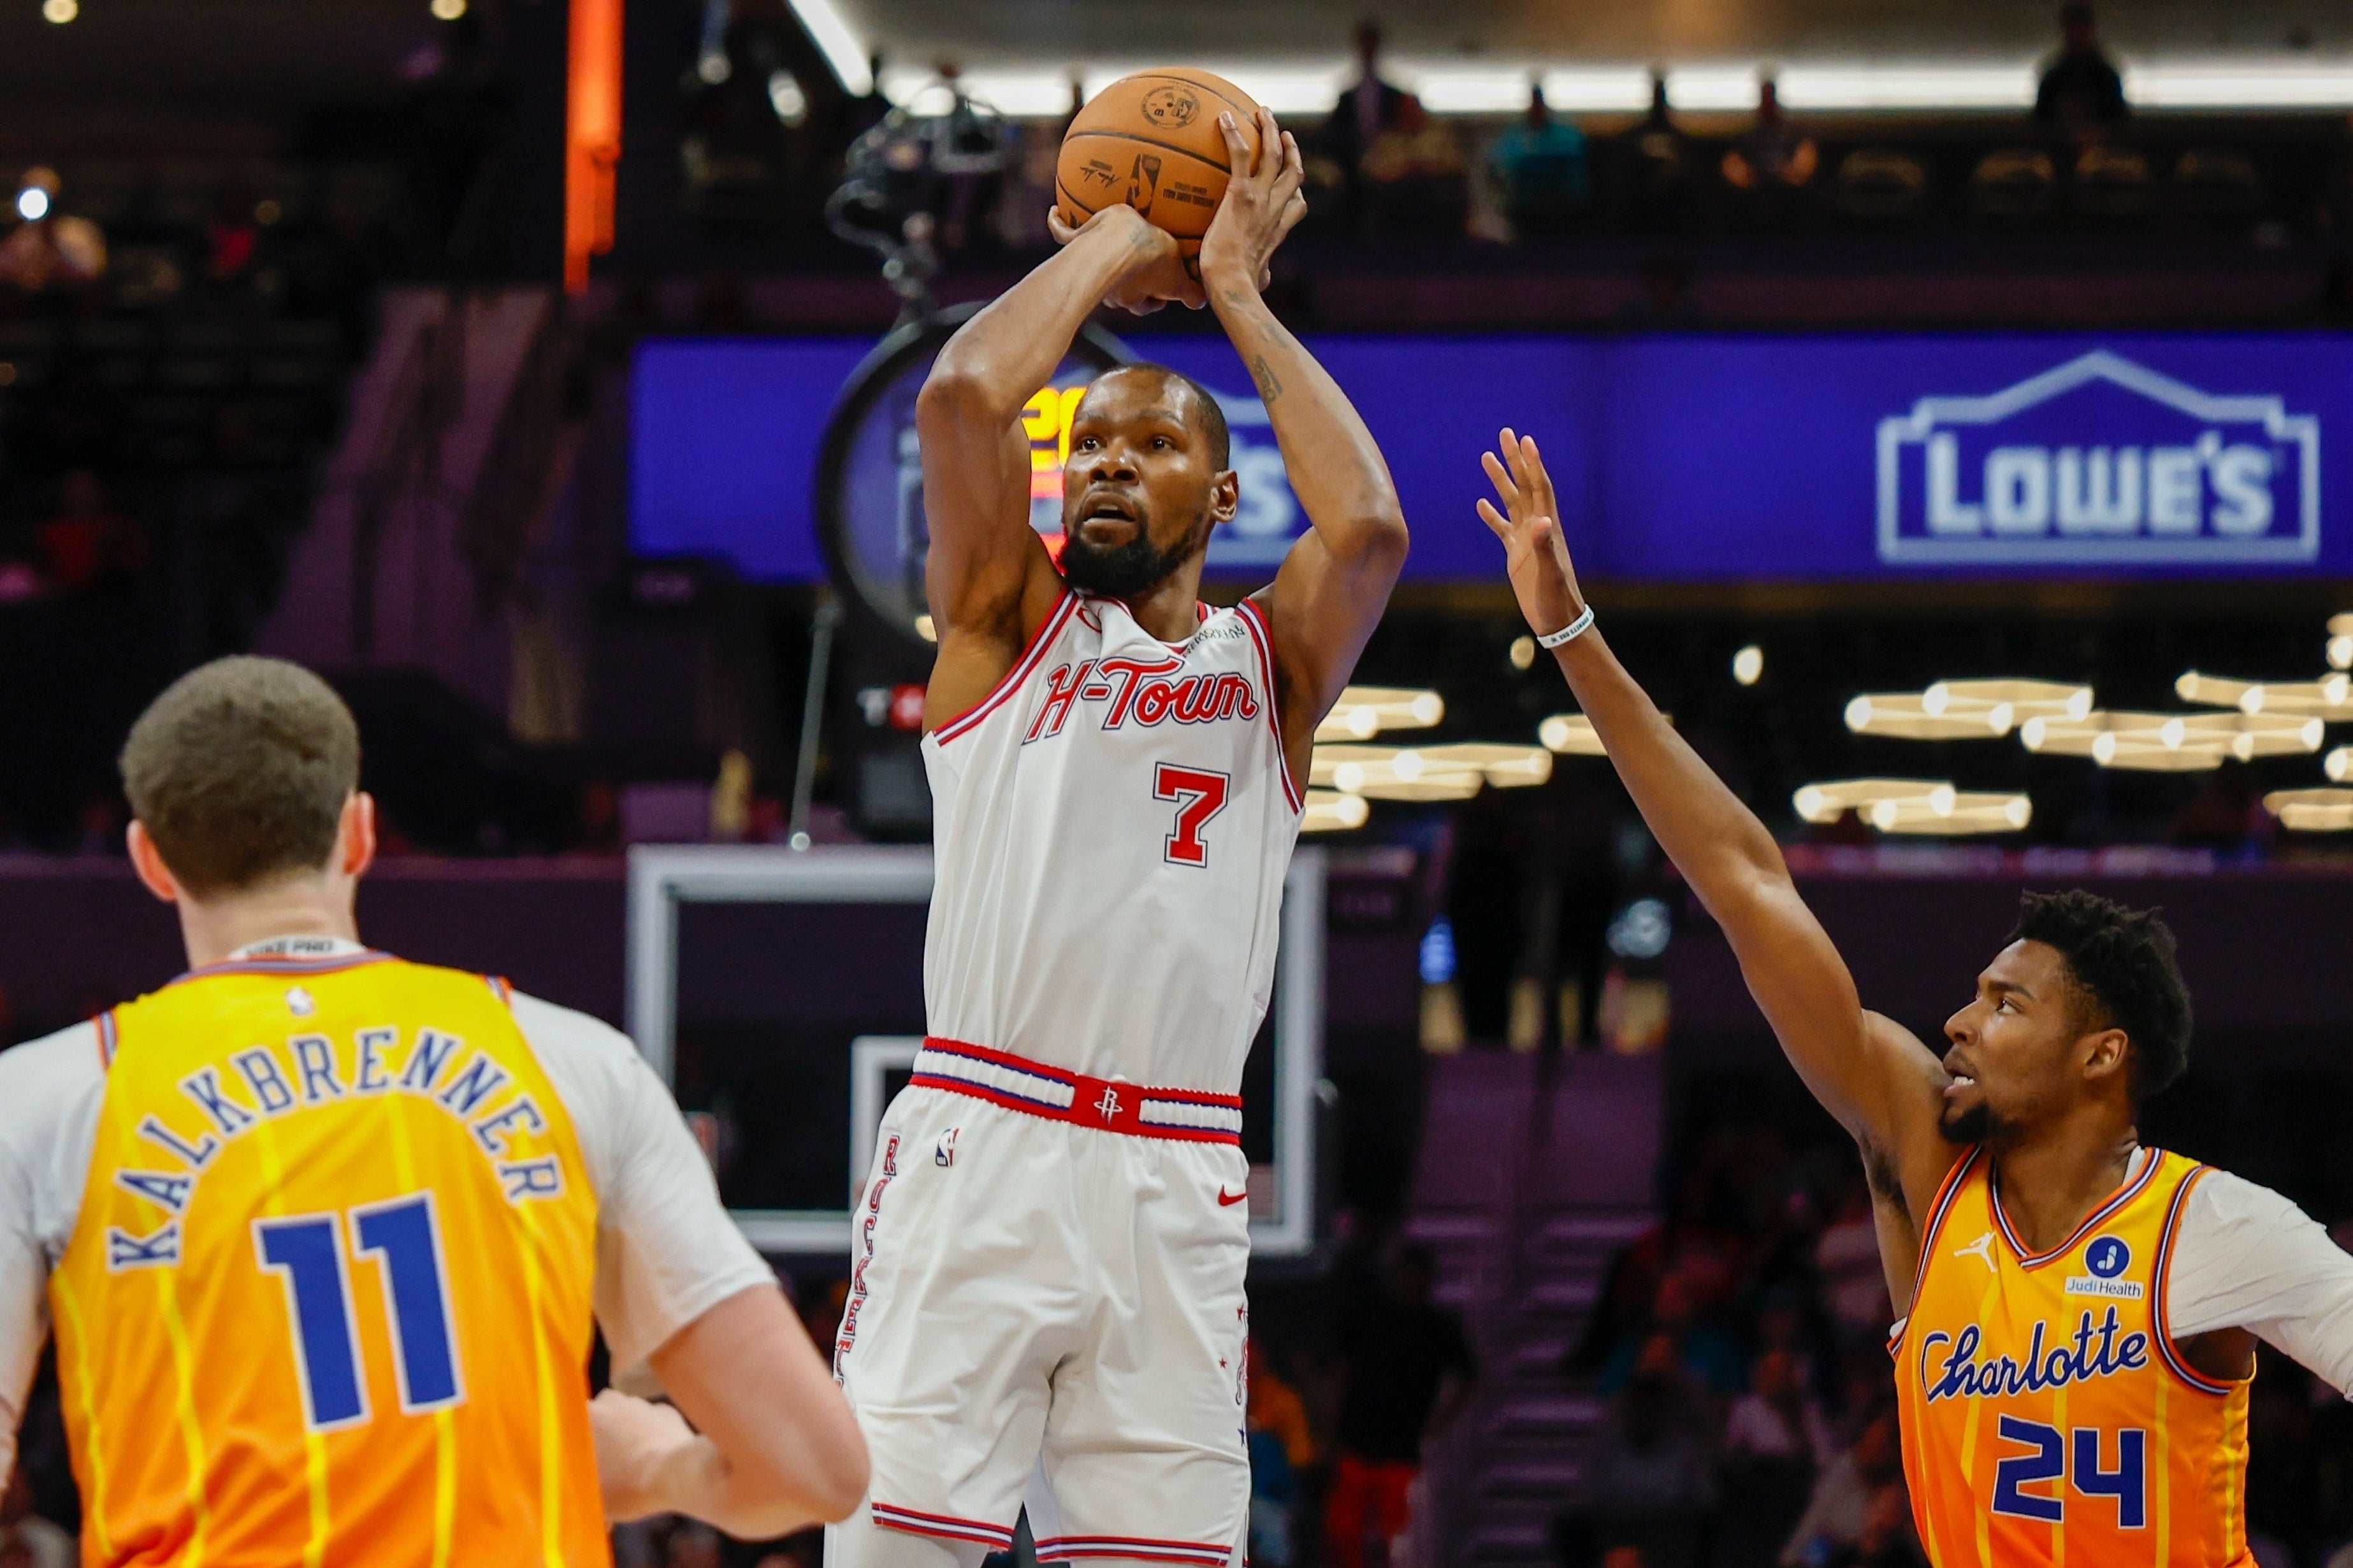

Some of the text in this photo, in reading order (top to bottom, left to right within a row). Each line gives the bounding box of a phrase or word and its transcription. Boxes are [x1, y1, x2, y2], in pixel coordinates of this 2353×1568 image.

[1925, 431, 2273, 536] LOWE'S
[1022, 656, 1259, 745] H-Town
[1152, 762, 1230, 868] 7
[107, 1025, 565, 1274] KALKBRENNER
[252, 1189, 467, 1435] 11
[834, 1135, 900, 1390] ROCKET
[2067, 1279, 2141, 1298] Judi Health
[1920, 1304, 2148, 1405] Charlotte
[1991, 1412, 2147, 1530] 24
